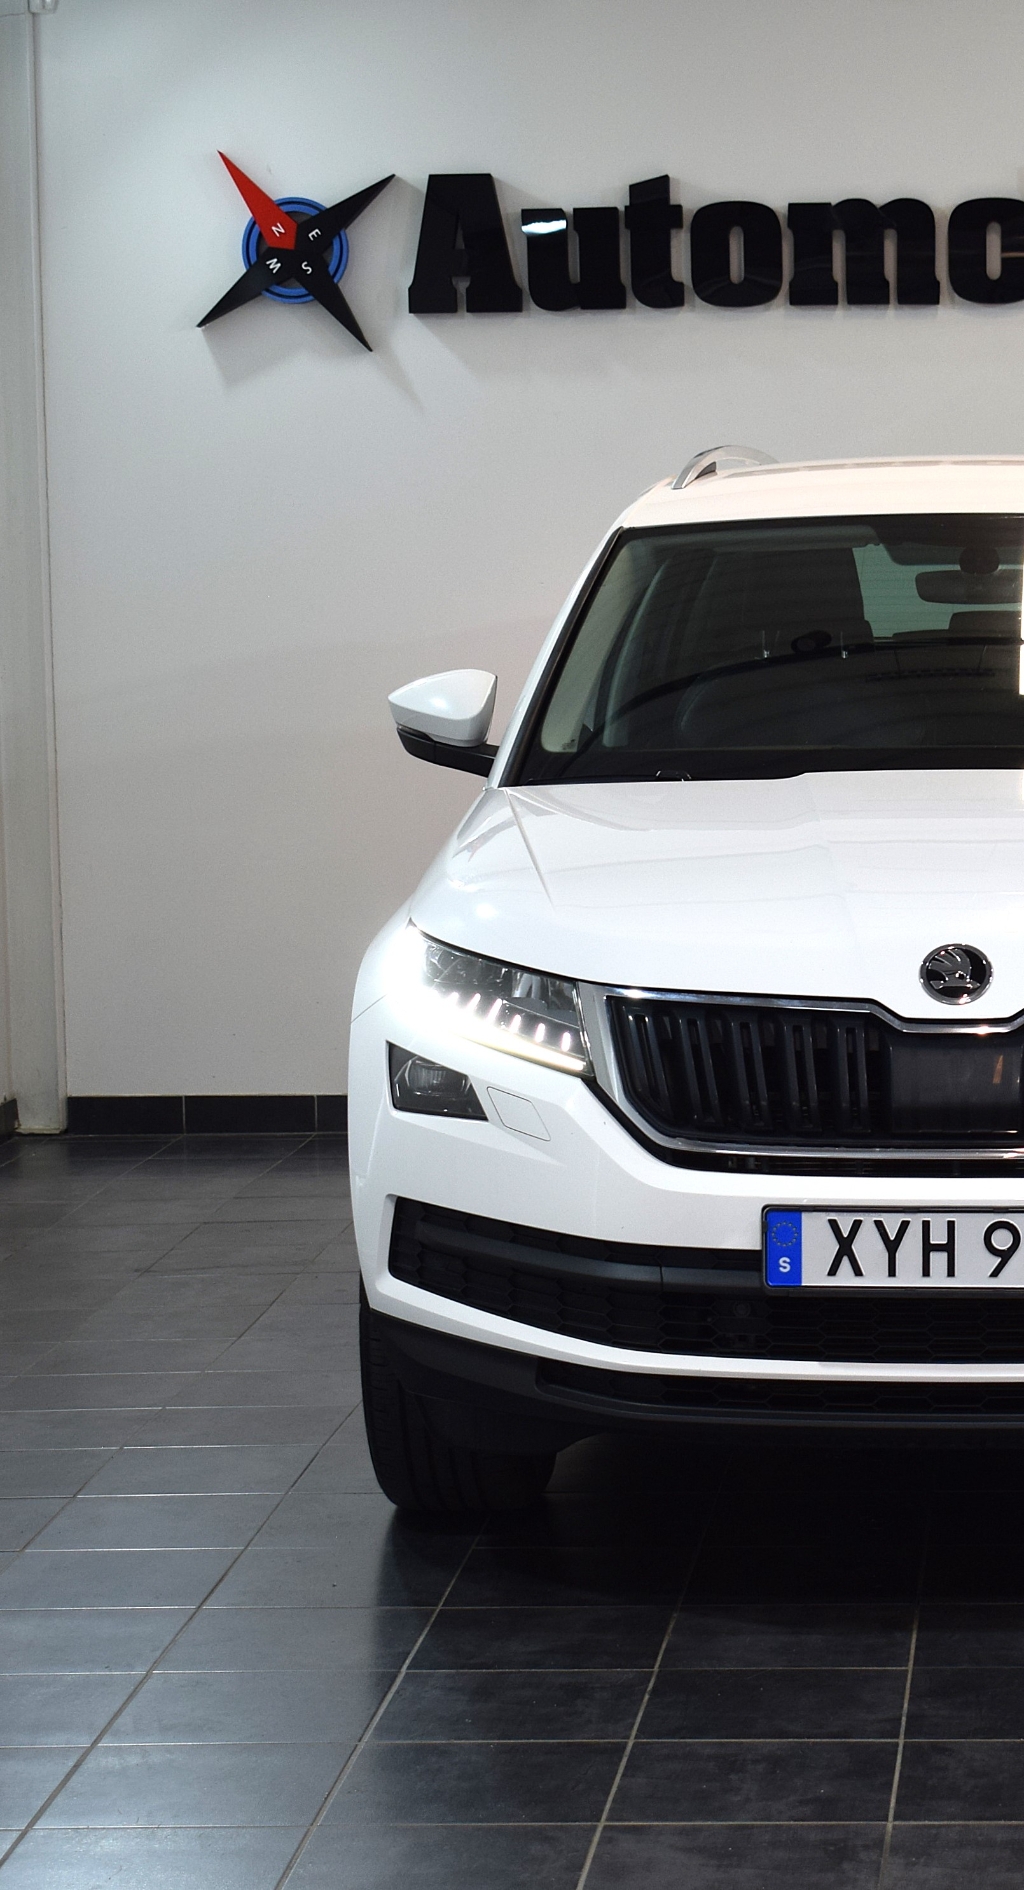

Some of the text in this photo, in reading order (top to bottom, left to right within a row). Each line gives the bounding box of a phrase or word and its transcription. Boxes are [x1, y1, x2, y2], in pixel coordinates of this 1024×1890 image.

[272, 223, 285, 237] N
[309, 229, 321, 241] E
[266, 258, 281, 274] W
[301, 262, 312, 274] S
[827, 1218, 957, 1278] XYH
[778, 1256, 791, 1273] S
